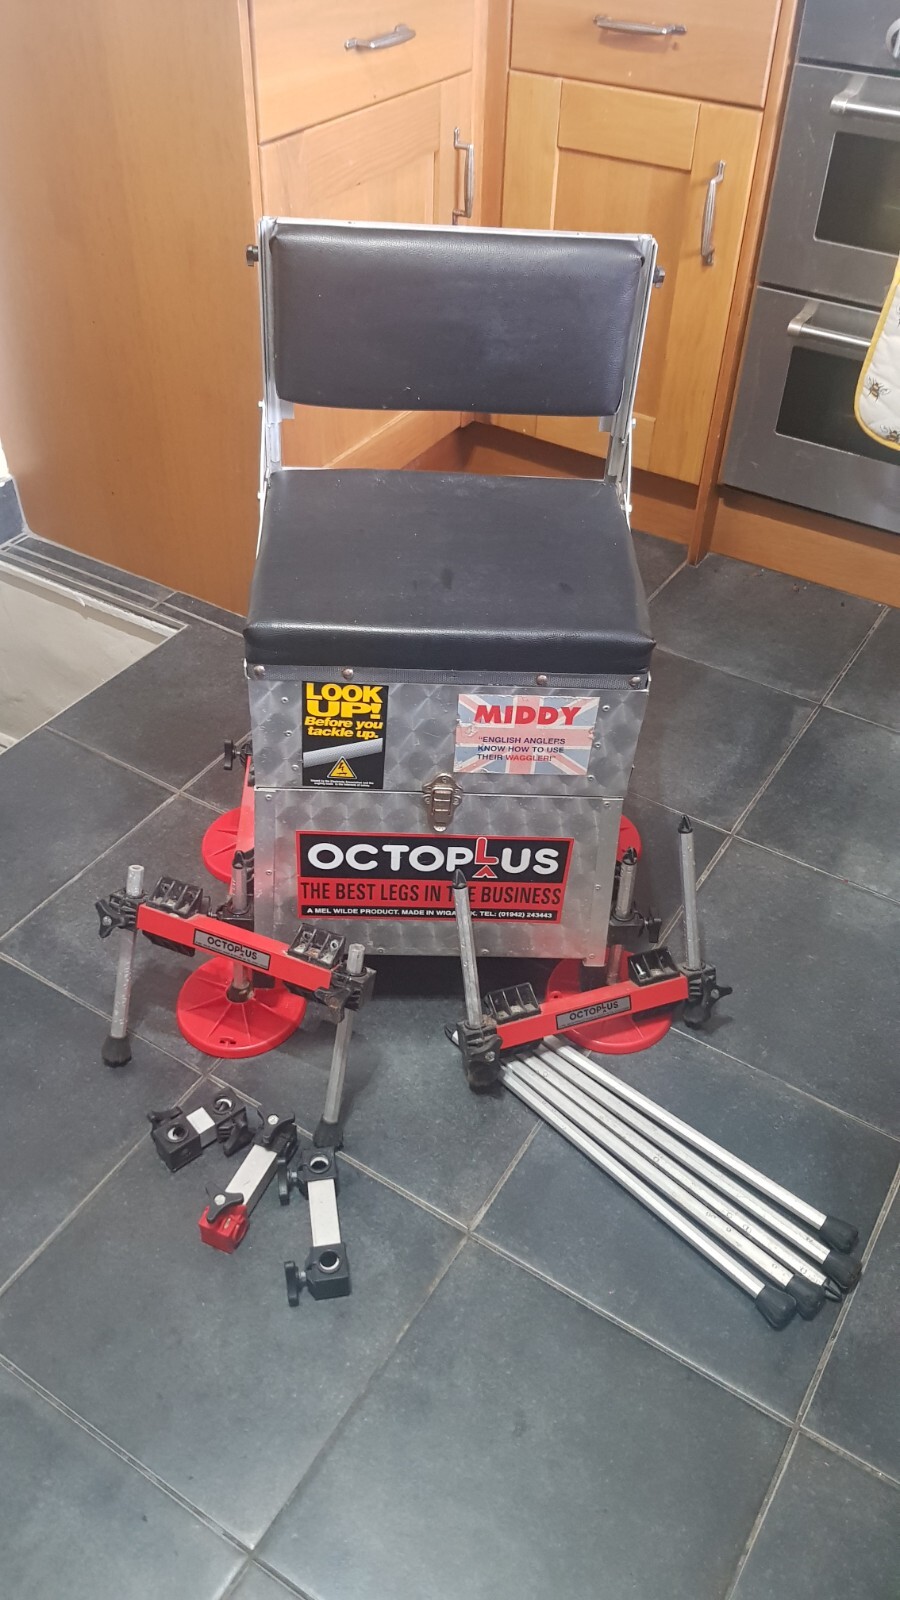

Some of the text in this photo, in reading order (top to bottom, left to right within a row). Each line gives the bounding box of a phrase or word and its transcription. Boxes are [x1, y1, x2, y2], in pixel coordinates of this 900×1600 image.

[306, 683, 383, 703] LOOK
[307, 700, 382, 719] UP!
[474, 705, 581, 726] MIDDY
[304, 716, 383, 730] Before you
[308, 726, 379, 740] tackle up.
[479, 736, 566, 745] "ENGLISH ANGLERS
[477, 753, 503, 761] THEIR
[307, 837, 559, 878] OCTOPLUS
[300, 882, 562, 905] THE BEST LEGS IN TE BUSINESS
[207, 936, 258, 960] OCTOPLUS
[569, 1001, 619, 1020] OCTOPLUS
